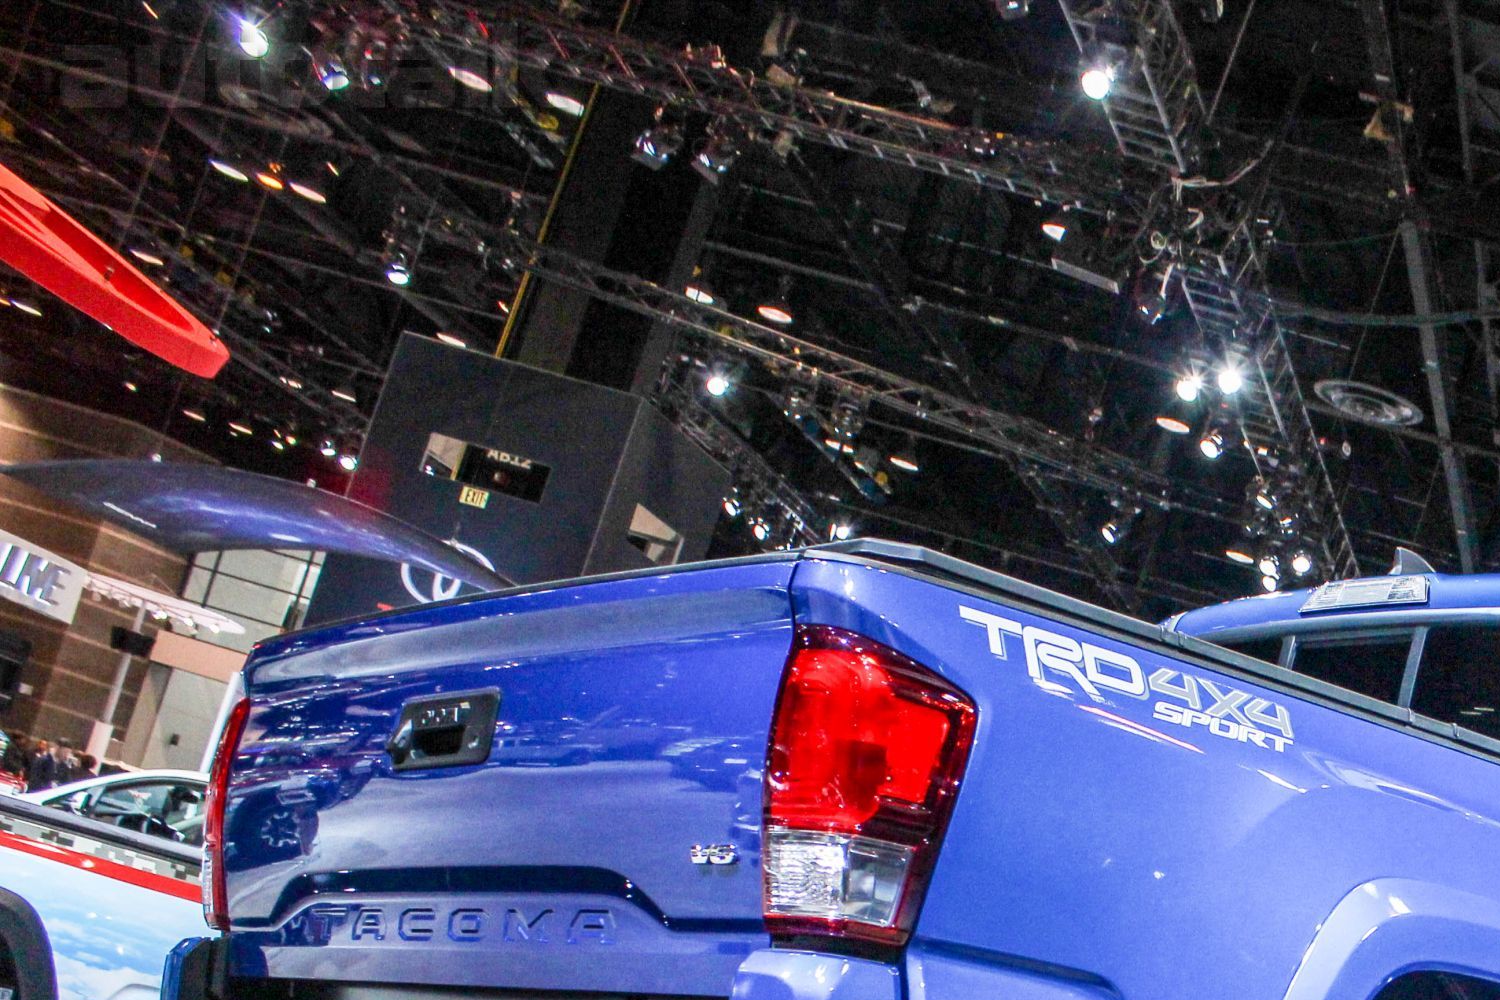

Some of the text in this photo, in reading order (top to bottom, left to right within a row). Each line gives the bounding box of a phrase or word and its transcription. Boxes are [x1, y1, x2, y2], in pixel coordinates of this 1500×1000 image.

[959, 604, 1150, 701] TRD
[1153, 701, 1293, 753] SPORT
[310, 907, 616, 945] TACOMA
